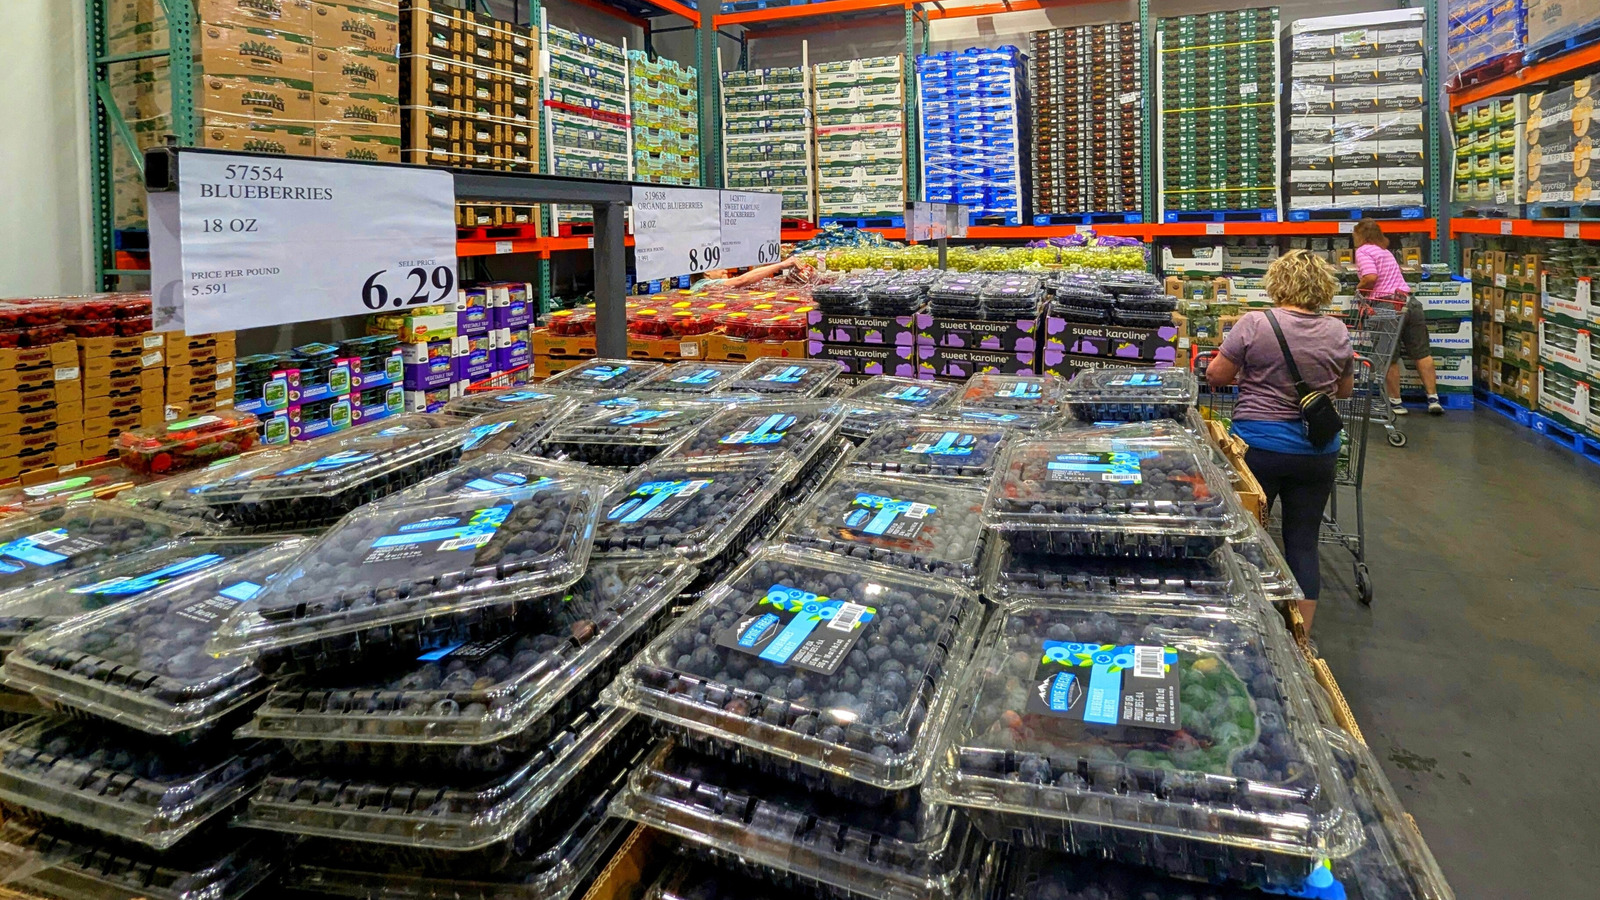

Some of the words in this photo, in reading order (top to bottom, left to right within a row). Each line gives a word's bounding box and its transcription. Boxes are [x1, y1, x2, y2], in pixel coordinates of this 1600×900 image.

[1546, 112, 1570, 124] APPLES
[1547, 152, 1572, 162] APPLES
[224, 163, 284, 182] 57554
[200, 183, 333, 200] BLUEBERRIES
[644, 191, 666, 201] 519638
[1546, 191, 1571, 200] APPLES
[637, 202, 666, 210] ORGANIC
[667, 201, 703, 210] BLUEBERRIES
[202, 218, 223, 233] 18
[229, 218, 258, 233] OZ
[647, 220, 656, 228] OZ
[758, 242, 779, 263] 6.99
[689, 245, 720, 271] 8.99
[398, 259, 415, 268] SELL
[191, 270, 222, 280] PRICE
[224, 268, 243, 278] PER
[246, 266, 280, 277] POUND
[191, 283, 227, 296] 5.591
[361, 264, 454, 310] 6.29
[828, 317, 852, 325] sweet
[940, 321, 967, 330] sweet
[1072, 327, 1102, 337] sweet
[828, 348, 851, 356] sweet
[941, 351, 967, 360] sweet
[1069, 359, 1099, 368] sweet
[467, 365, 485, 373] VEGETABLE
[741, 624, 759, 646] ALPINE
[756, 614, 779, 630] FRESH
[1056, 672, 1073, 690] FRESH
[1052, 689, 1066, 709] ALPINE
